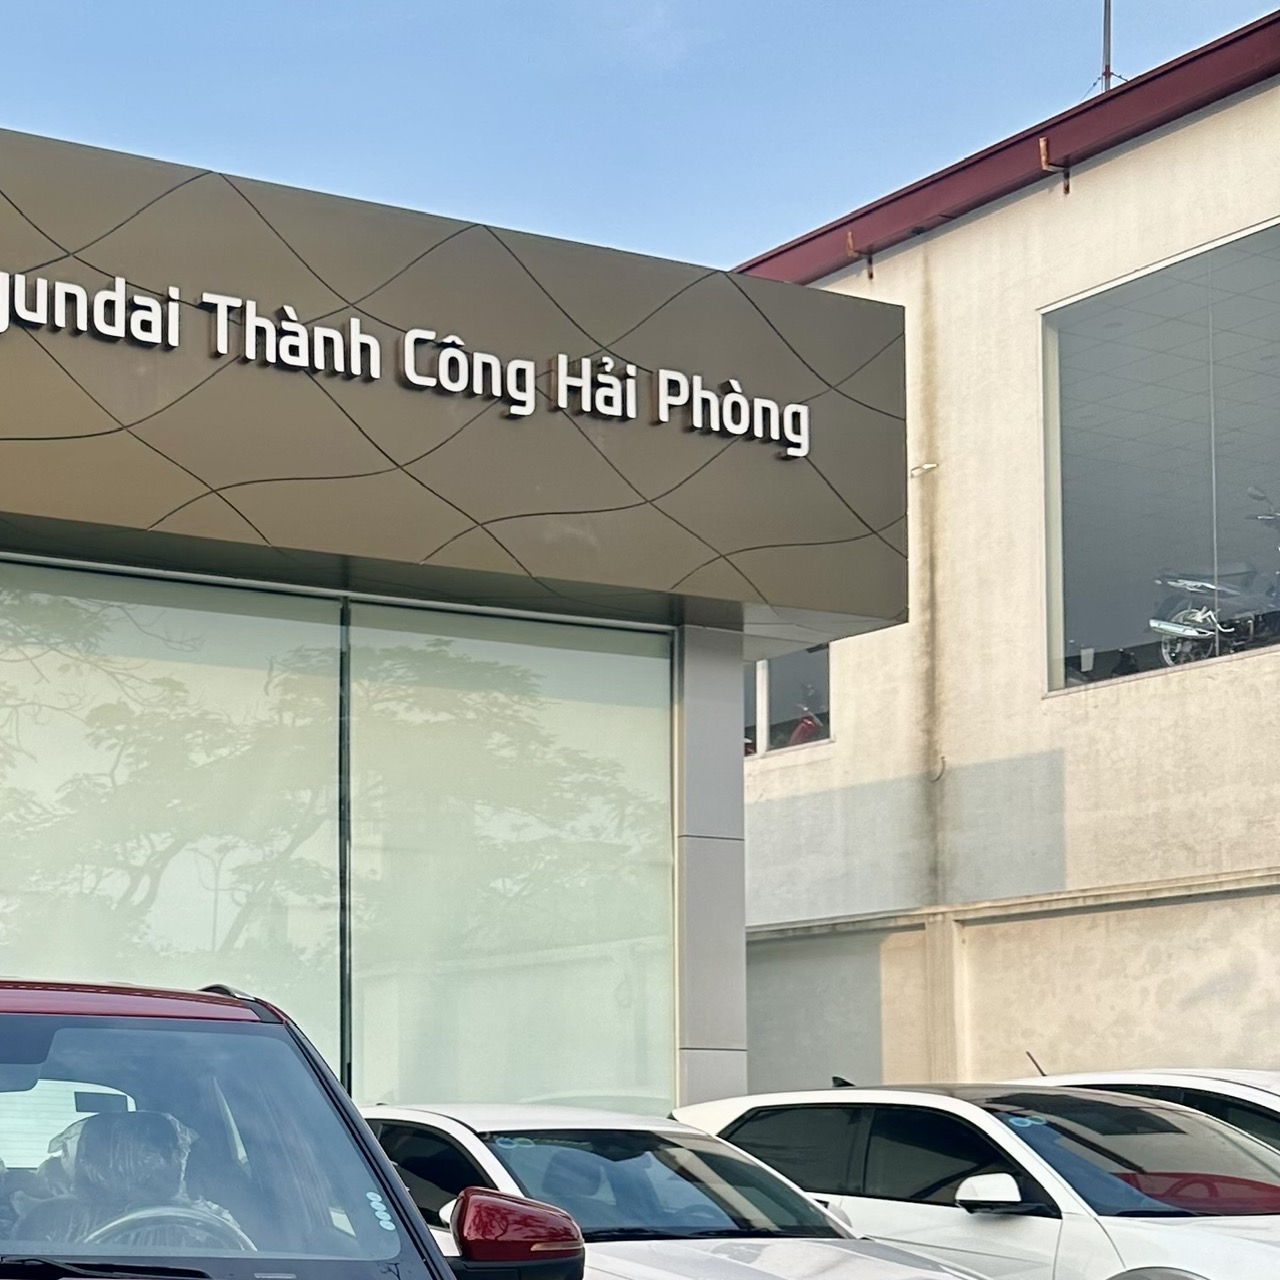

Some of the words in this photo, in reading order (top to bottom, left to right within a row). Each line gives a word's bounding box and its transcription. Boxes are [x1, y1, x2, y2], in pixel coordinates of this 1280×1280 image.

[202, 292, 382, 379] Thành
[404, 328, 536, 416] Công
[557, 353, 638, 420] Hải
[658, 369, 810, 458] Phòng
